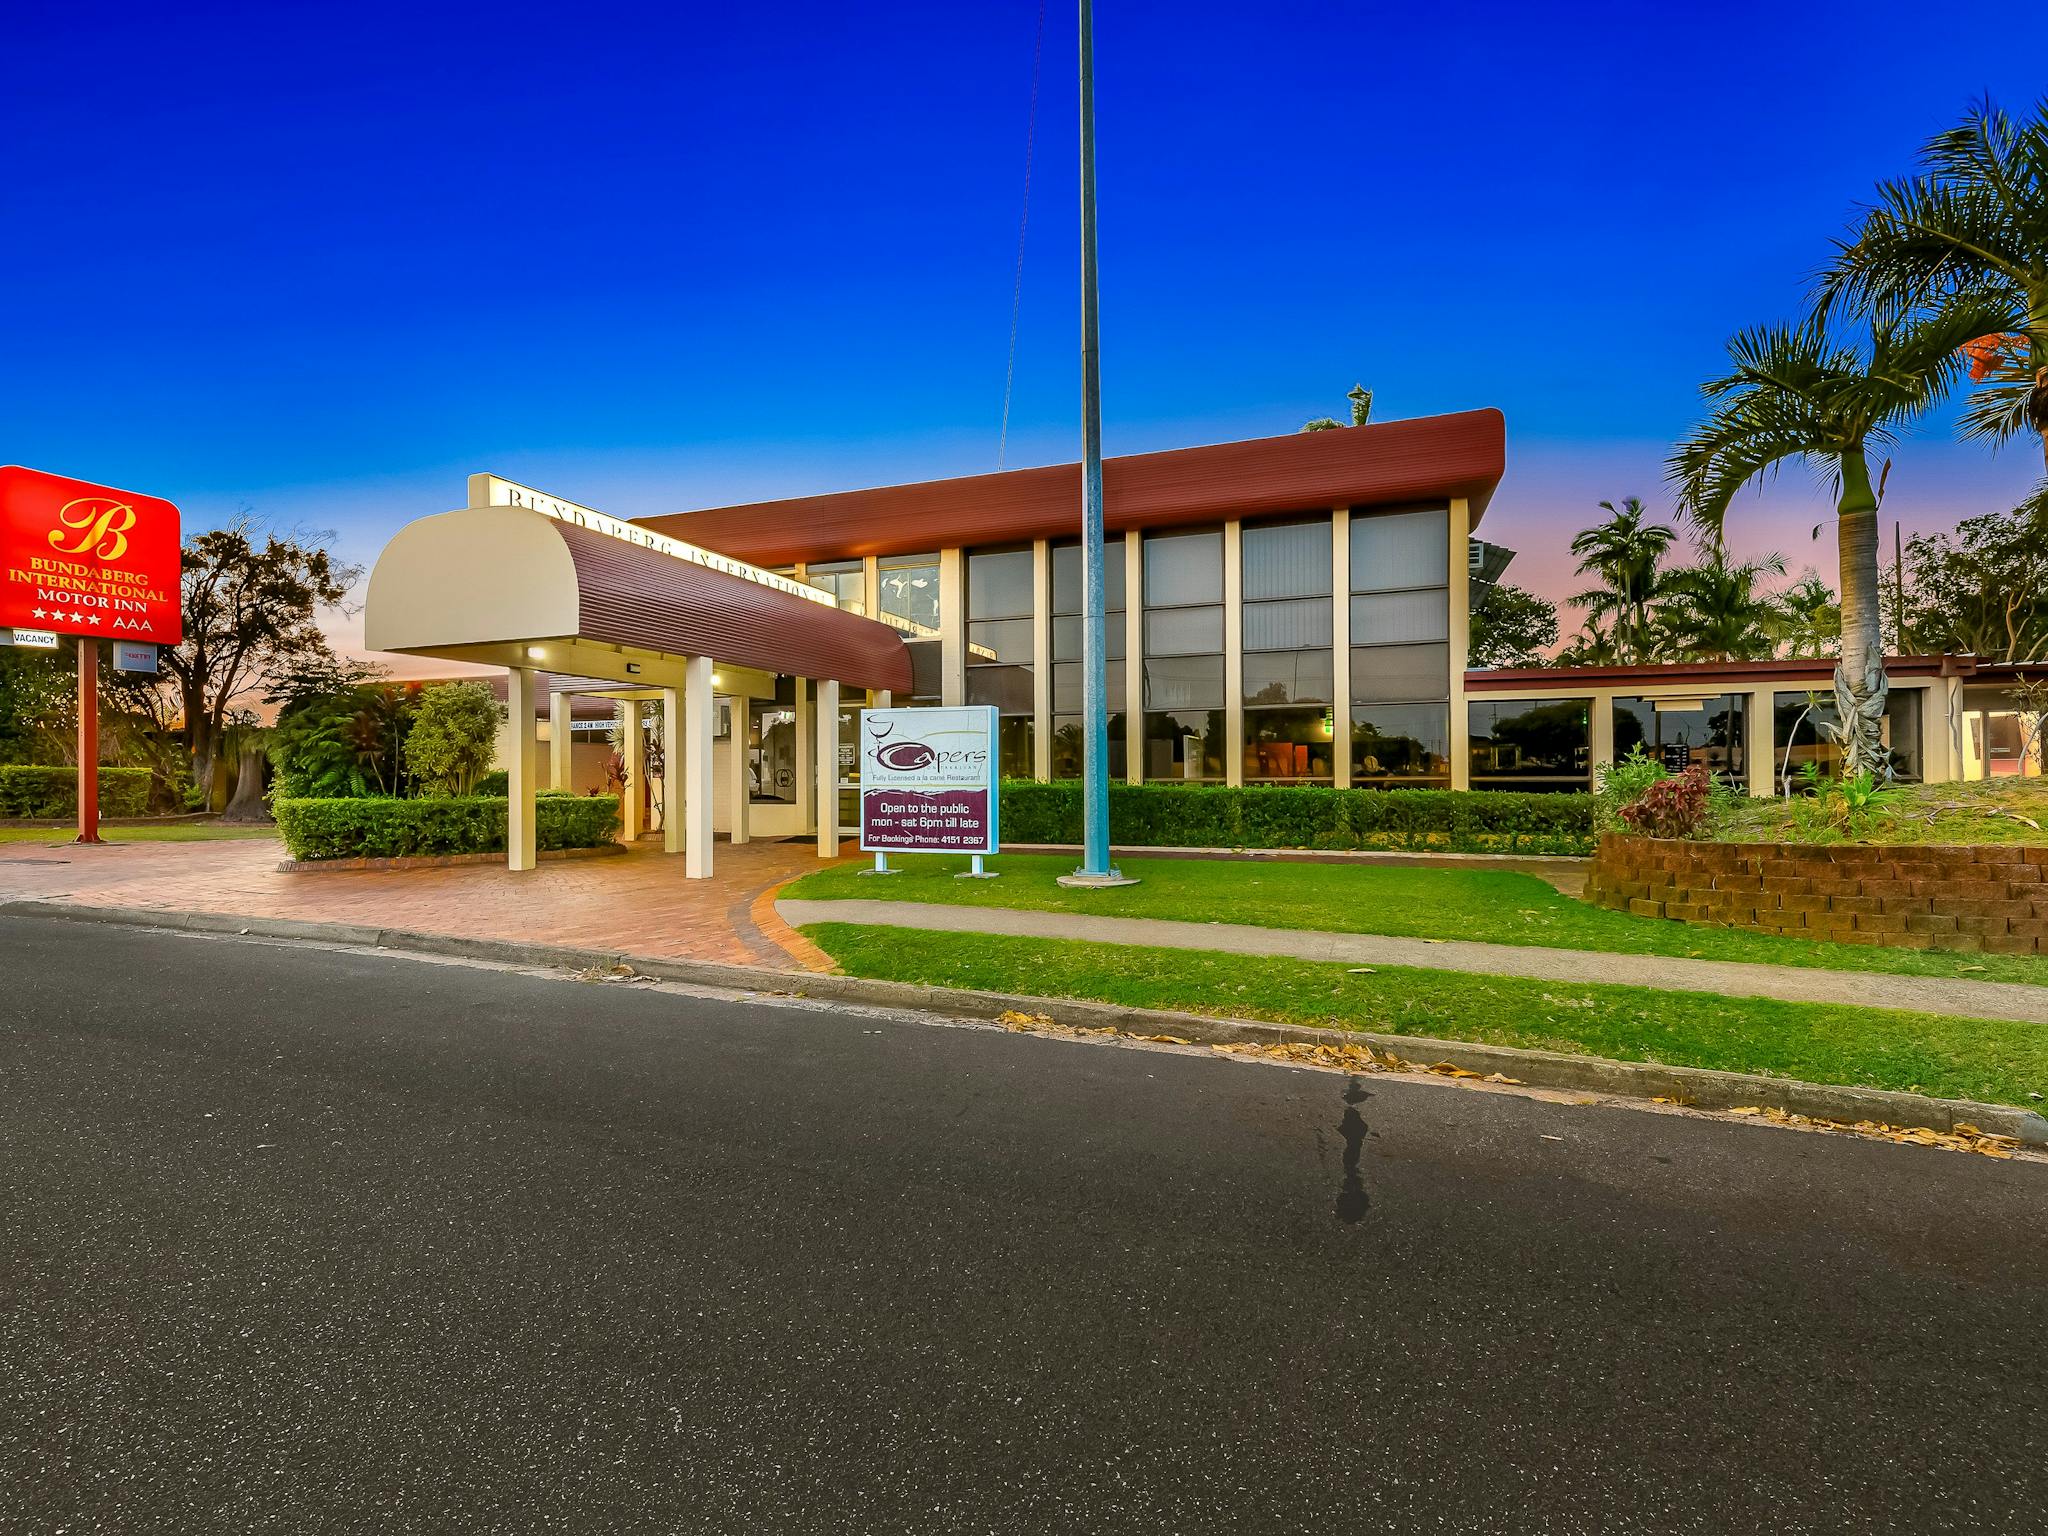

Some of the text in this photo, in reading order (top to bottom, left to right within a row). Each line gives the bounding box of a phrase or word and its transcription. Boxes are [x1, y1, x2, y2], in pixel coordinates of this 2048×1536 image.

[47, 496, 137, 561] B
[508, 488, 673, 556] BUNDABERG
[30, 557, 149, 586] BUNDABERG
[8, 569, 169, 602] INTERNATIONAL
[37, 588, 148, 613] MOTOR INN
[112, 616, 154, 632] AAA
[14, 633, 55, 645] VACANCY
[876, 742, 986, 773] Capers
[880, 803, 970, 816] Open to the public
[872, 818, 893, 827] mon
[901, 818, 918, 827] sat
[920, 817, 943, 829] 6pm
[945, 818, 958, 828] till
[960, 818, 980, 829] late
[868, 834, 985, 845] For Bookings Phone: 4151 2367
